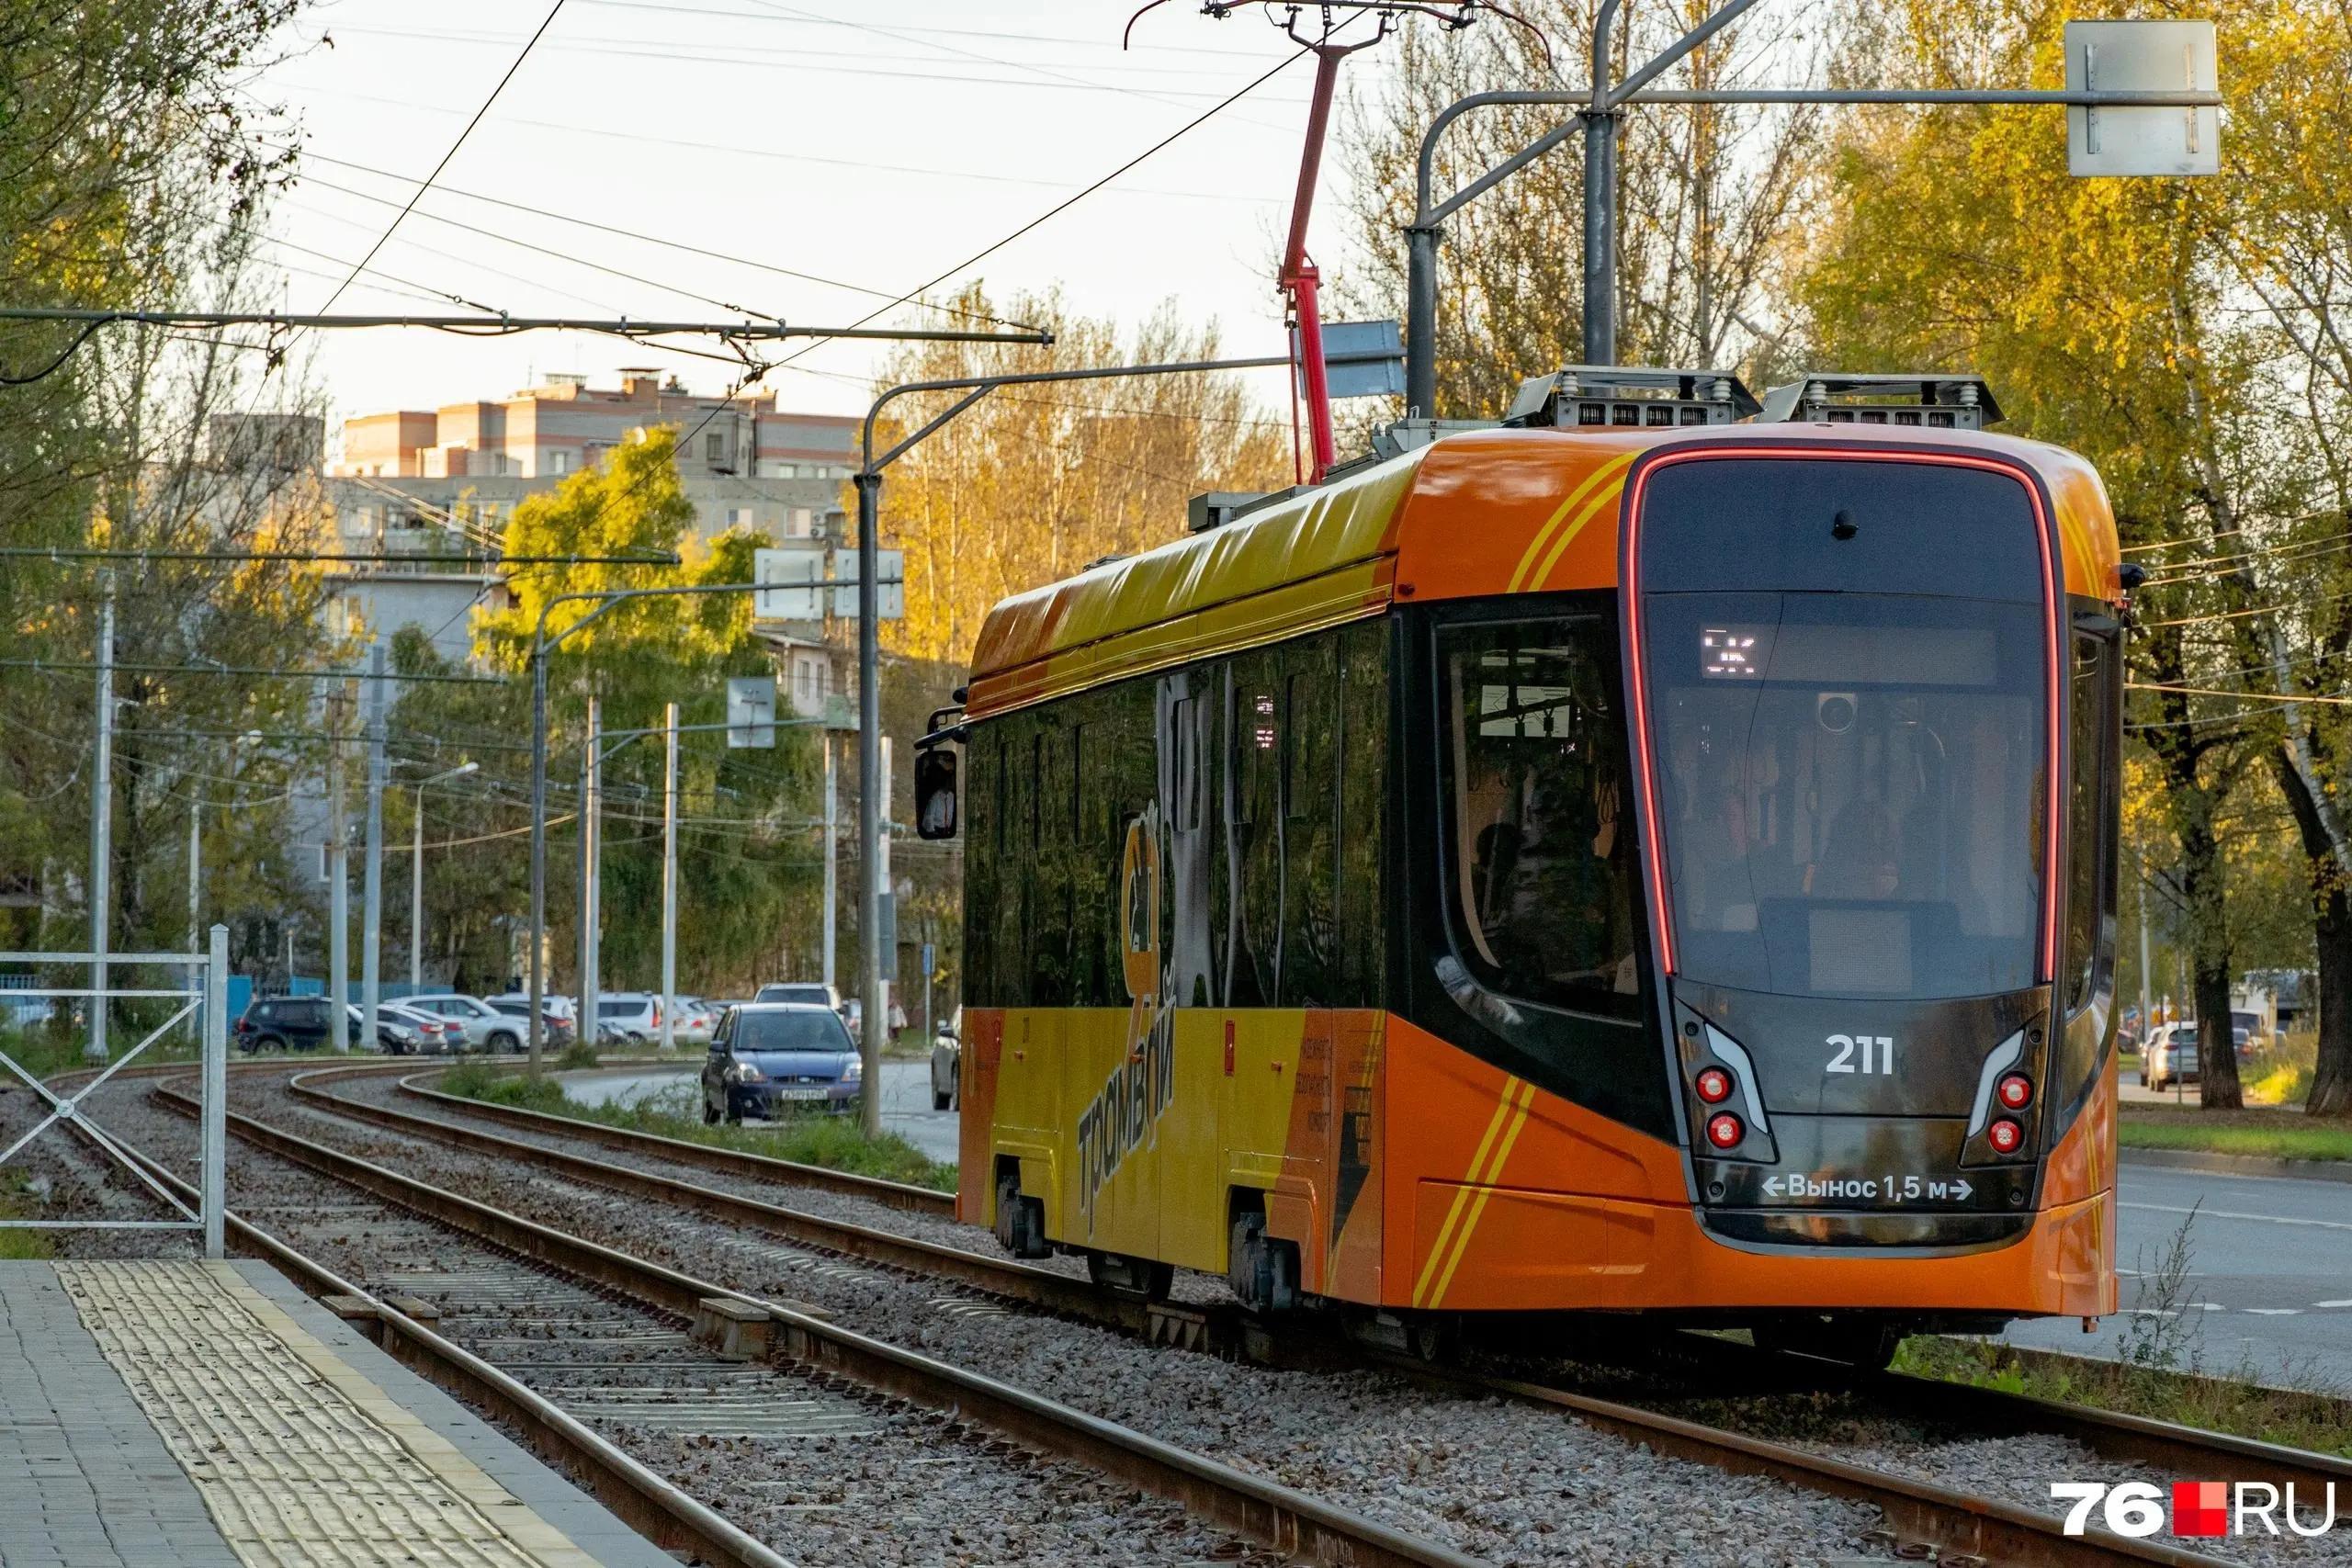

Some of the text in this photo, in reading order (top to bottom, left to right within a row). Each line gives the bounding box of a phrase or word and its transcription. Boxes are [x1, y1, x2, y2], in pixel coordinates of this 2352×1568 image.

[1826, 1033, 1894, 1076] 211
[1788, 1174, 1948, 1202] Вынос 1,5 м
